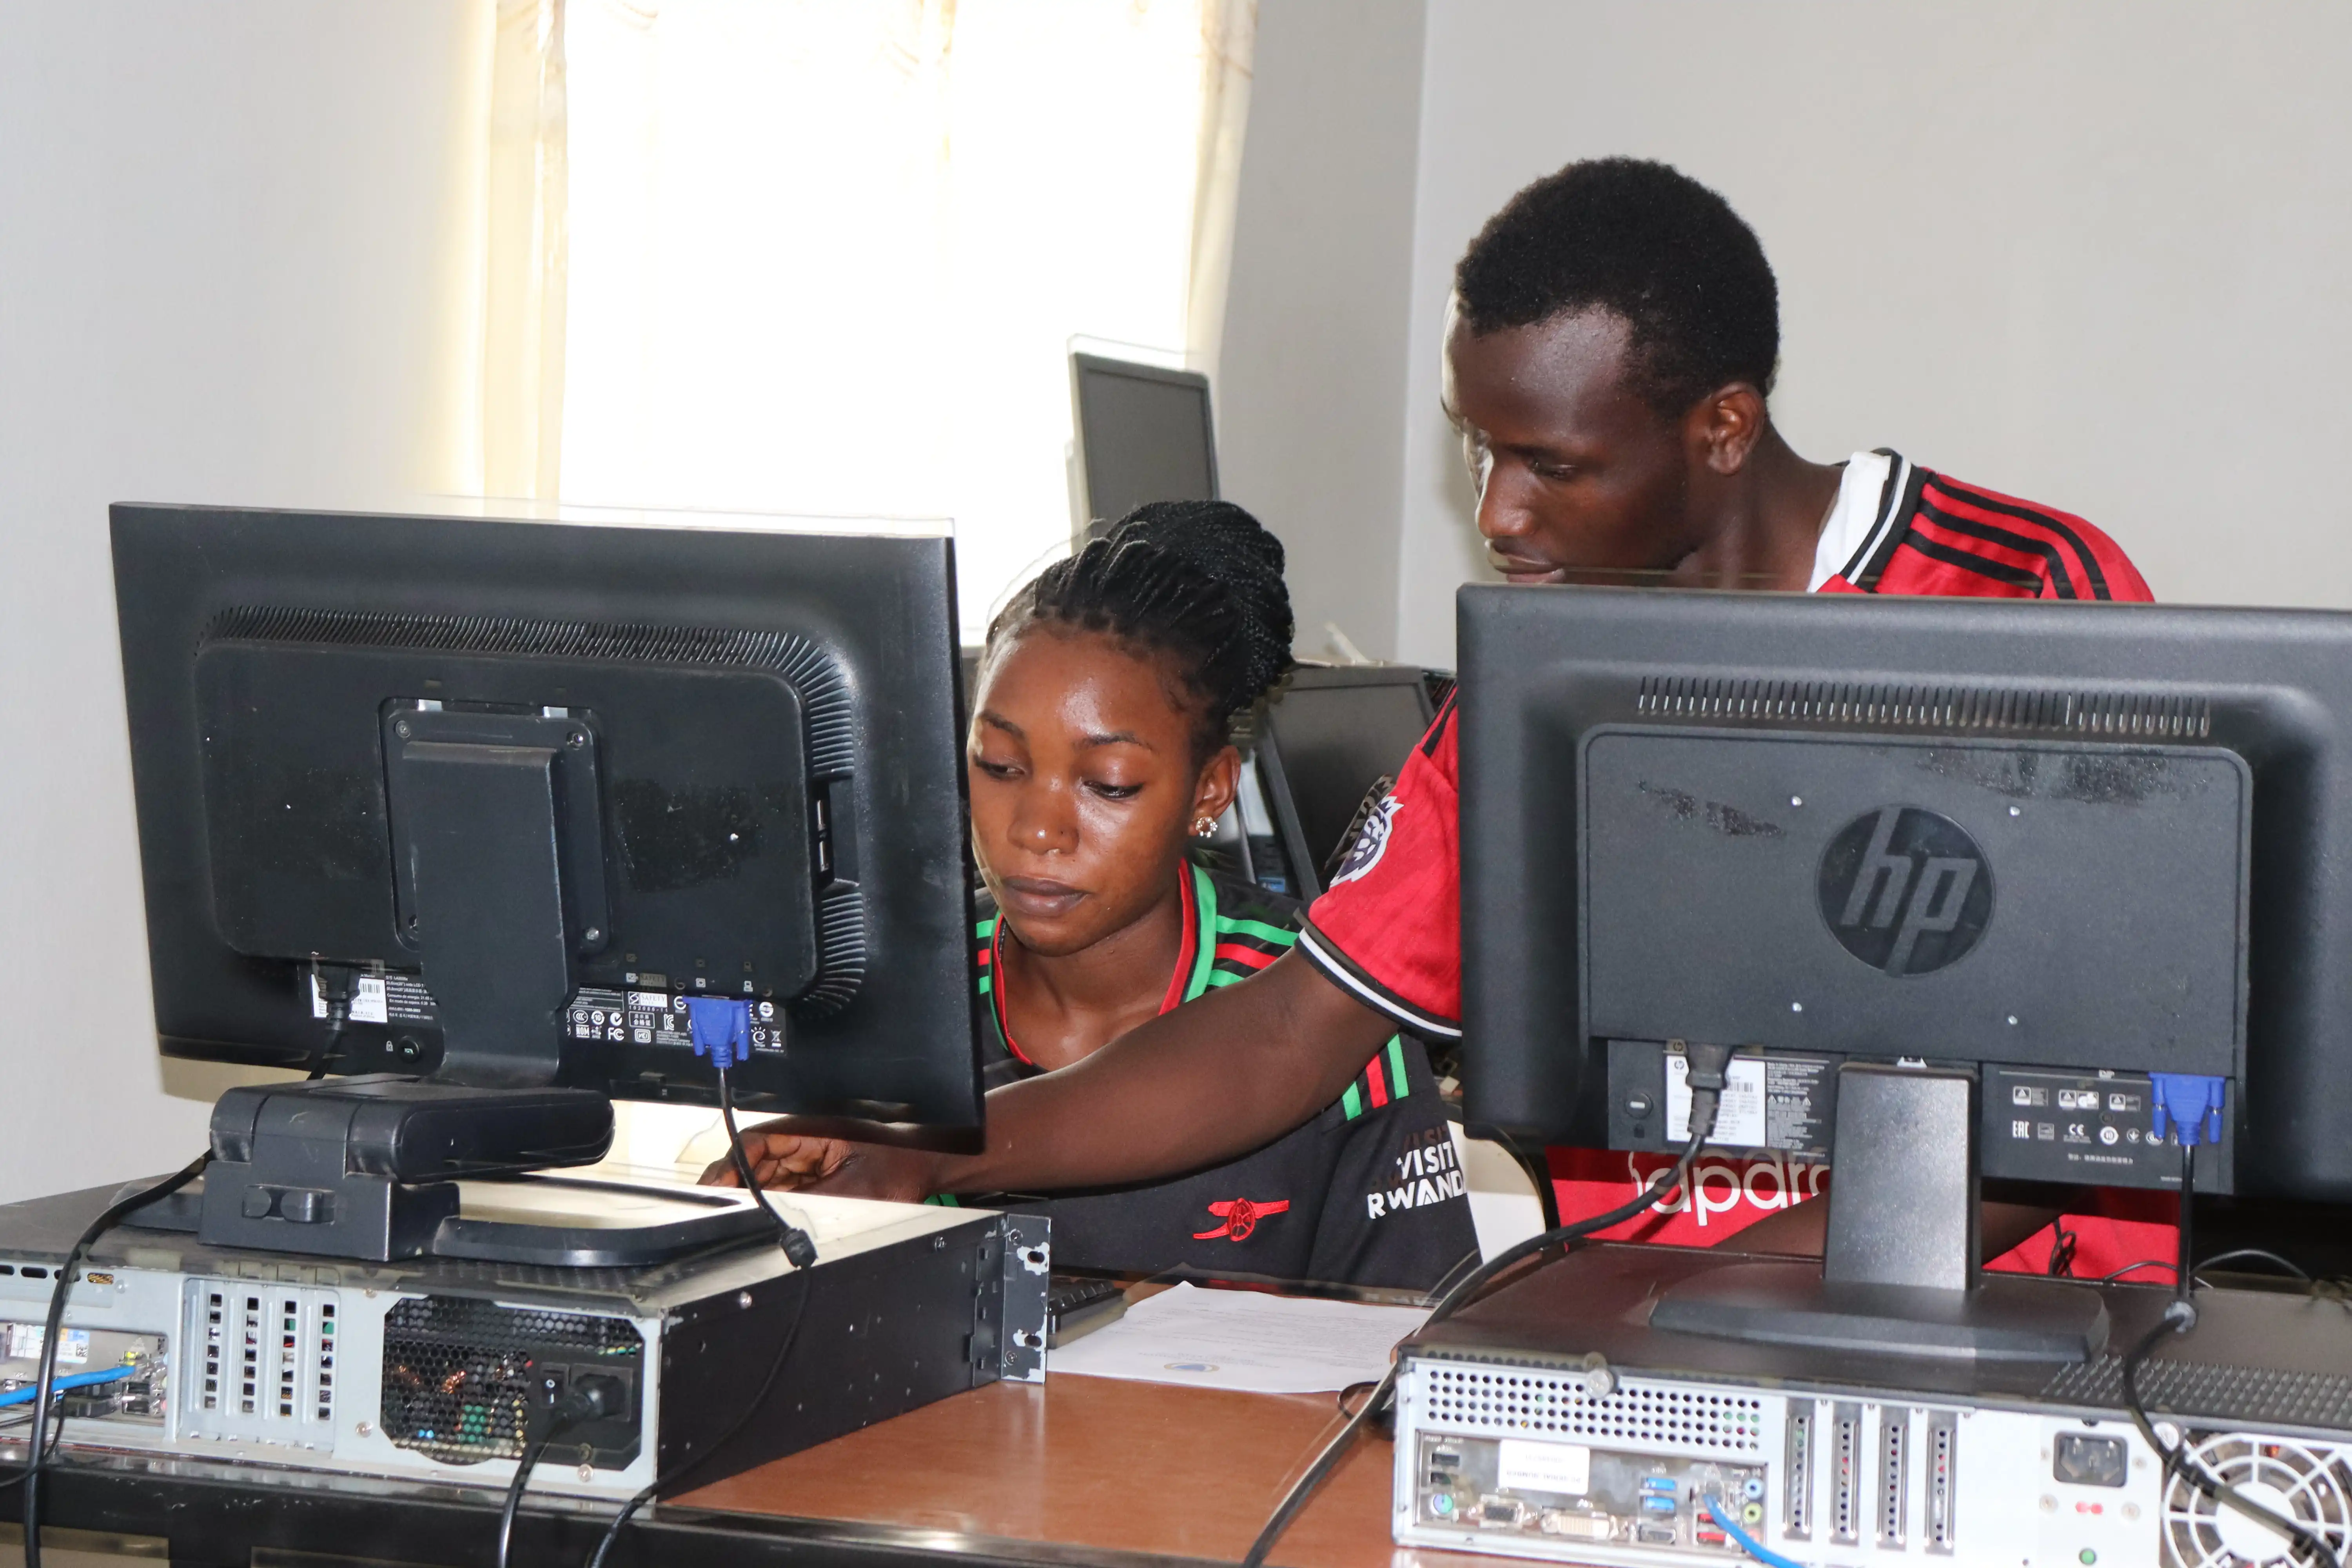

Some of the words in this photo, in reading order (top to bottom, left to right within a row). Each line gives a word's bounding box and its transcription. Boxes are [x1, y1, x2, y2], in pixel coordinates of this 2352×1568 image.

[1840, 808, 1977, 978] hp
[576, 1026, 590, 1036] NOM
[2012, 1120, 2030, 1139] EAC
[2068, 1123, 2085, 1137] CE
[1396, 1141, 1454, 1180] VISIT
[1367, 1170, 1467, 1219] RWAND
